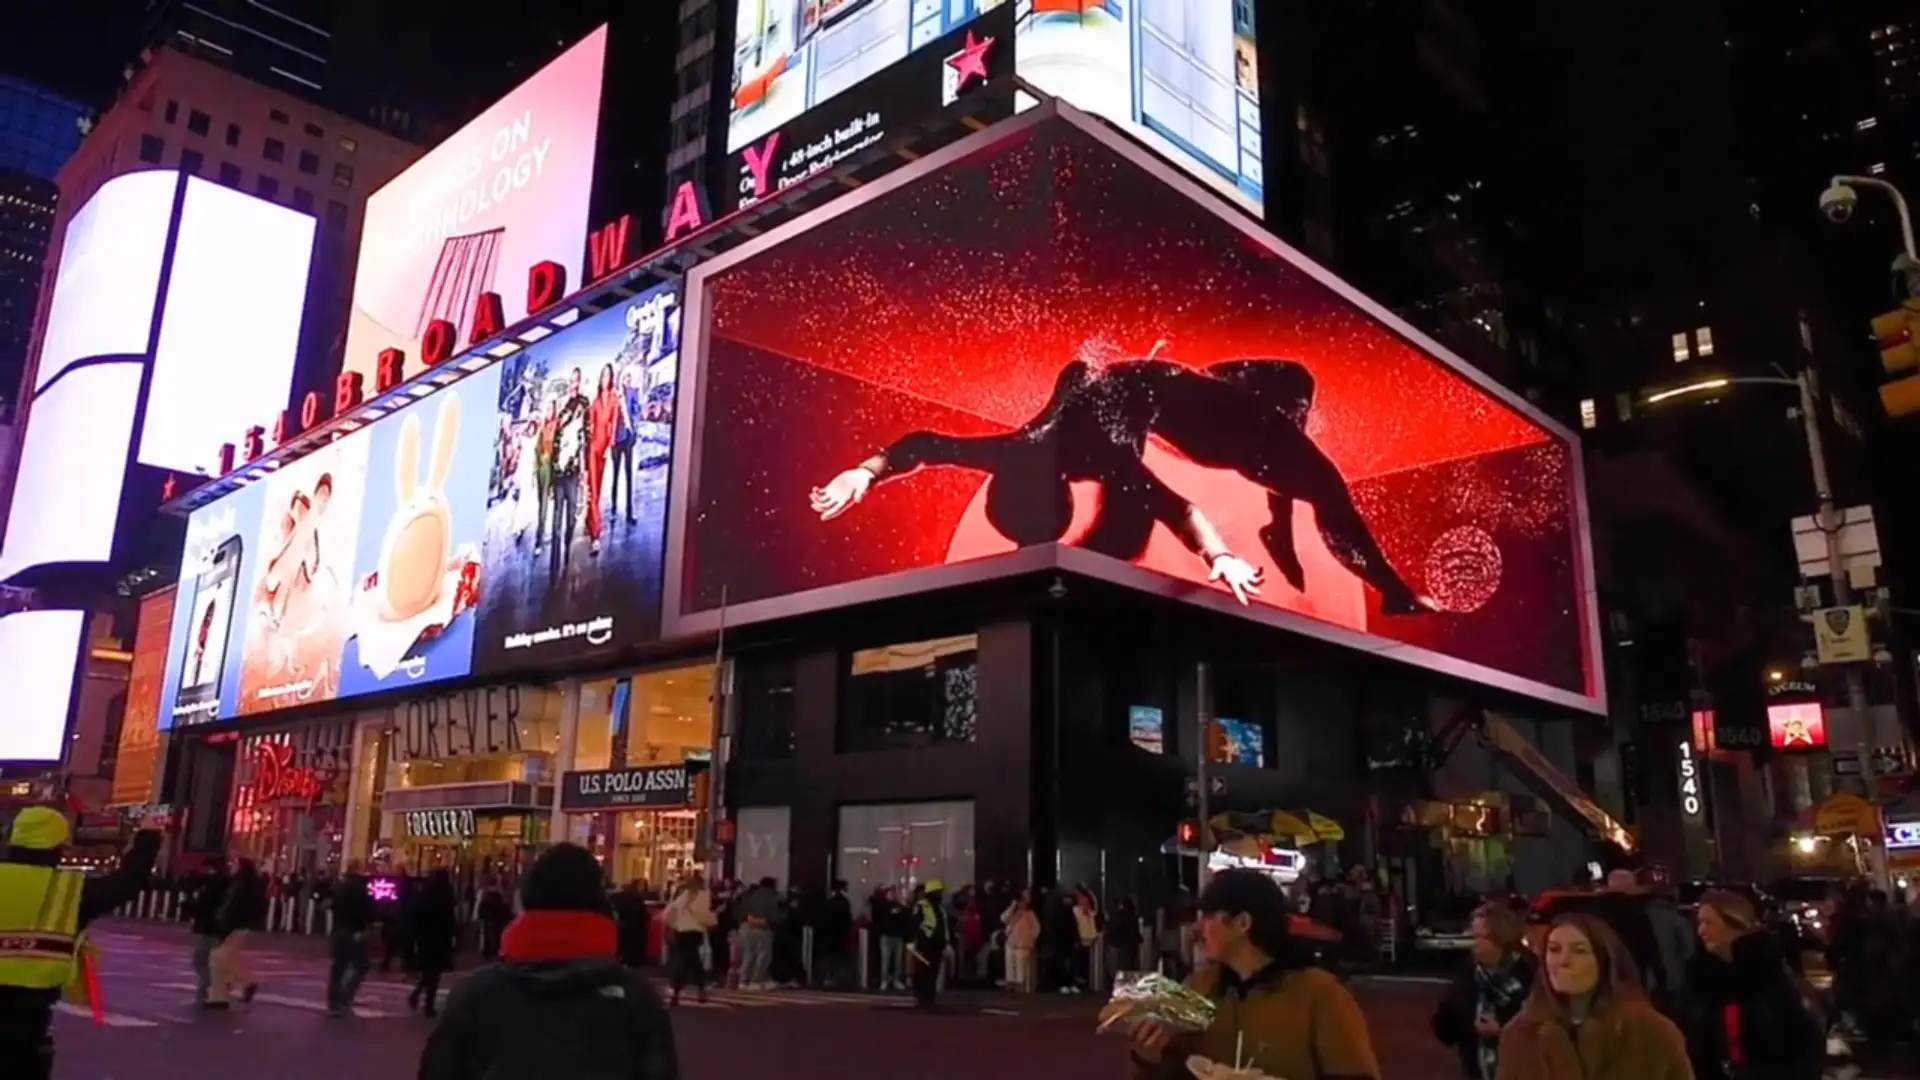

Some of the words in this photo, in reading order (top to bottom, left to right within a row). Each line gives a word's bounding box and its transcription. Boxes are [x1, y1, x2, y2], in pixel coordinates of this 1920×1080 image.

[218, 391, 317, 477] 1540
[335, 131, 780, 416] BROADWAY
[390, 684, 522, 763] FOREVER
[579, 774, 601, 794] U.S.
[604, 771, 644, 793] POLO
[1680, 741, 1699, 815] 1540
[406, 809, 459, 837] FOREVER
